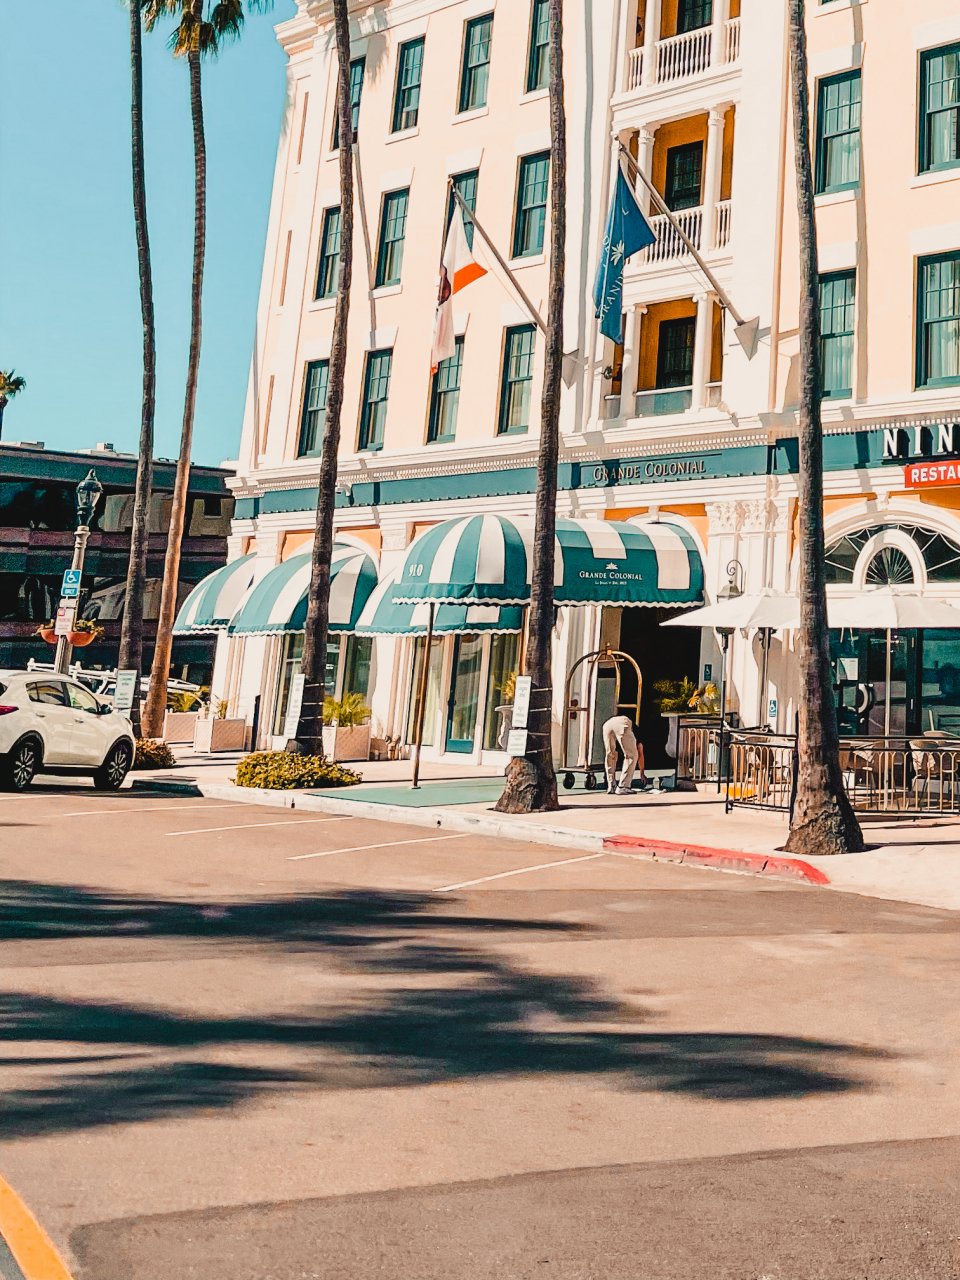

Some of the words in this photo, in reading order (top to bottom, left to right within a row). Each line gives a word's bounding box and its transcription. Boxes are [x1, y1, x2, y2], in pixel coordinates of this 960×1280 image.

[593, 466, 640, 481] GRANDE
[645, 460, 706, 477] COLONIAL
[579, 571, 607, 579] GRANDE
[609, 572, 643, 580] COLONIAL
